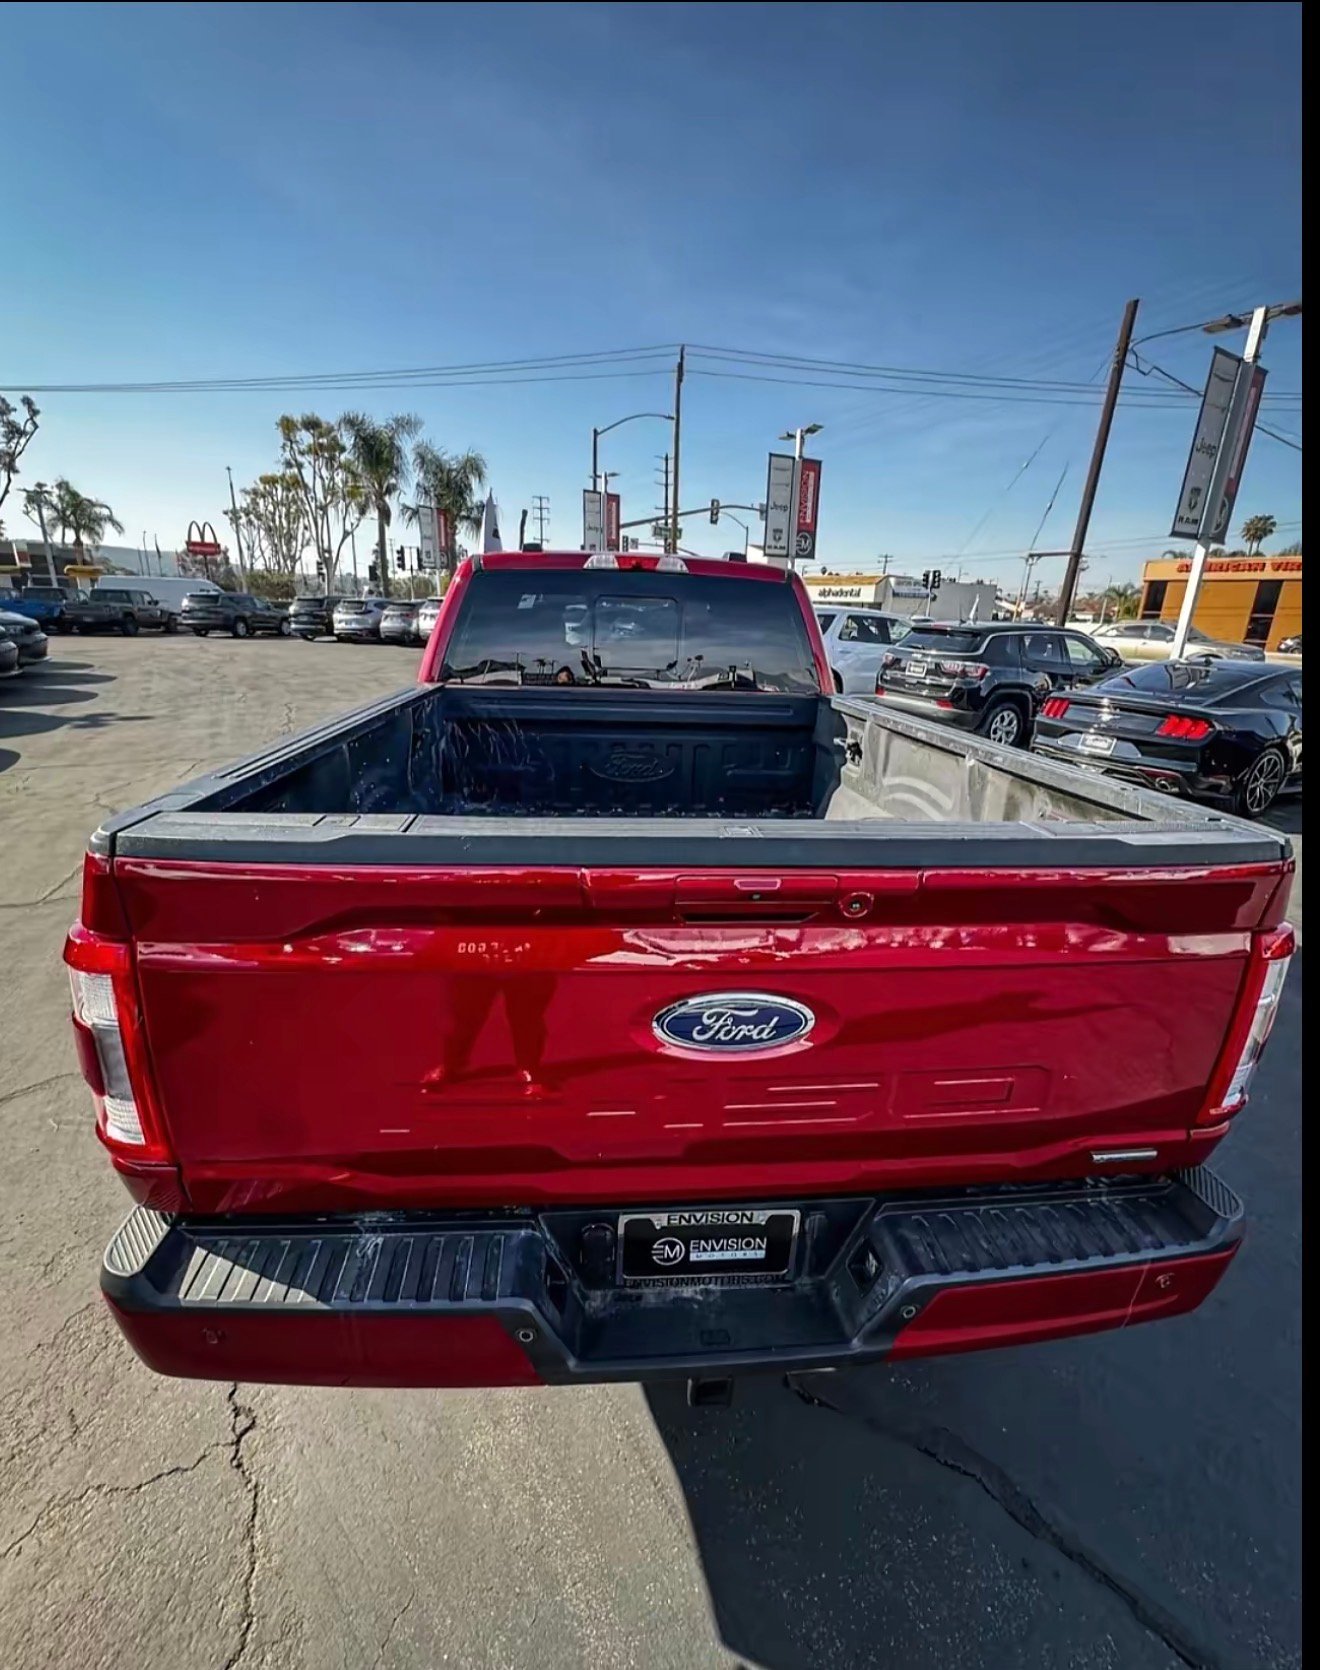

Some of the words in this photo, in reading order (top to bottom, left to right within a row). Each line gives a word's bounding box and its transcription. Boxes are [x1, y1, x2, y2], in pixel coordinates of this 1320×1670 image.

[692, 1007, 780, 1041] Ford
[667, 1212, 754, 1226] ENVISION
[690, 1237, 767, 1252] ENVISION
